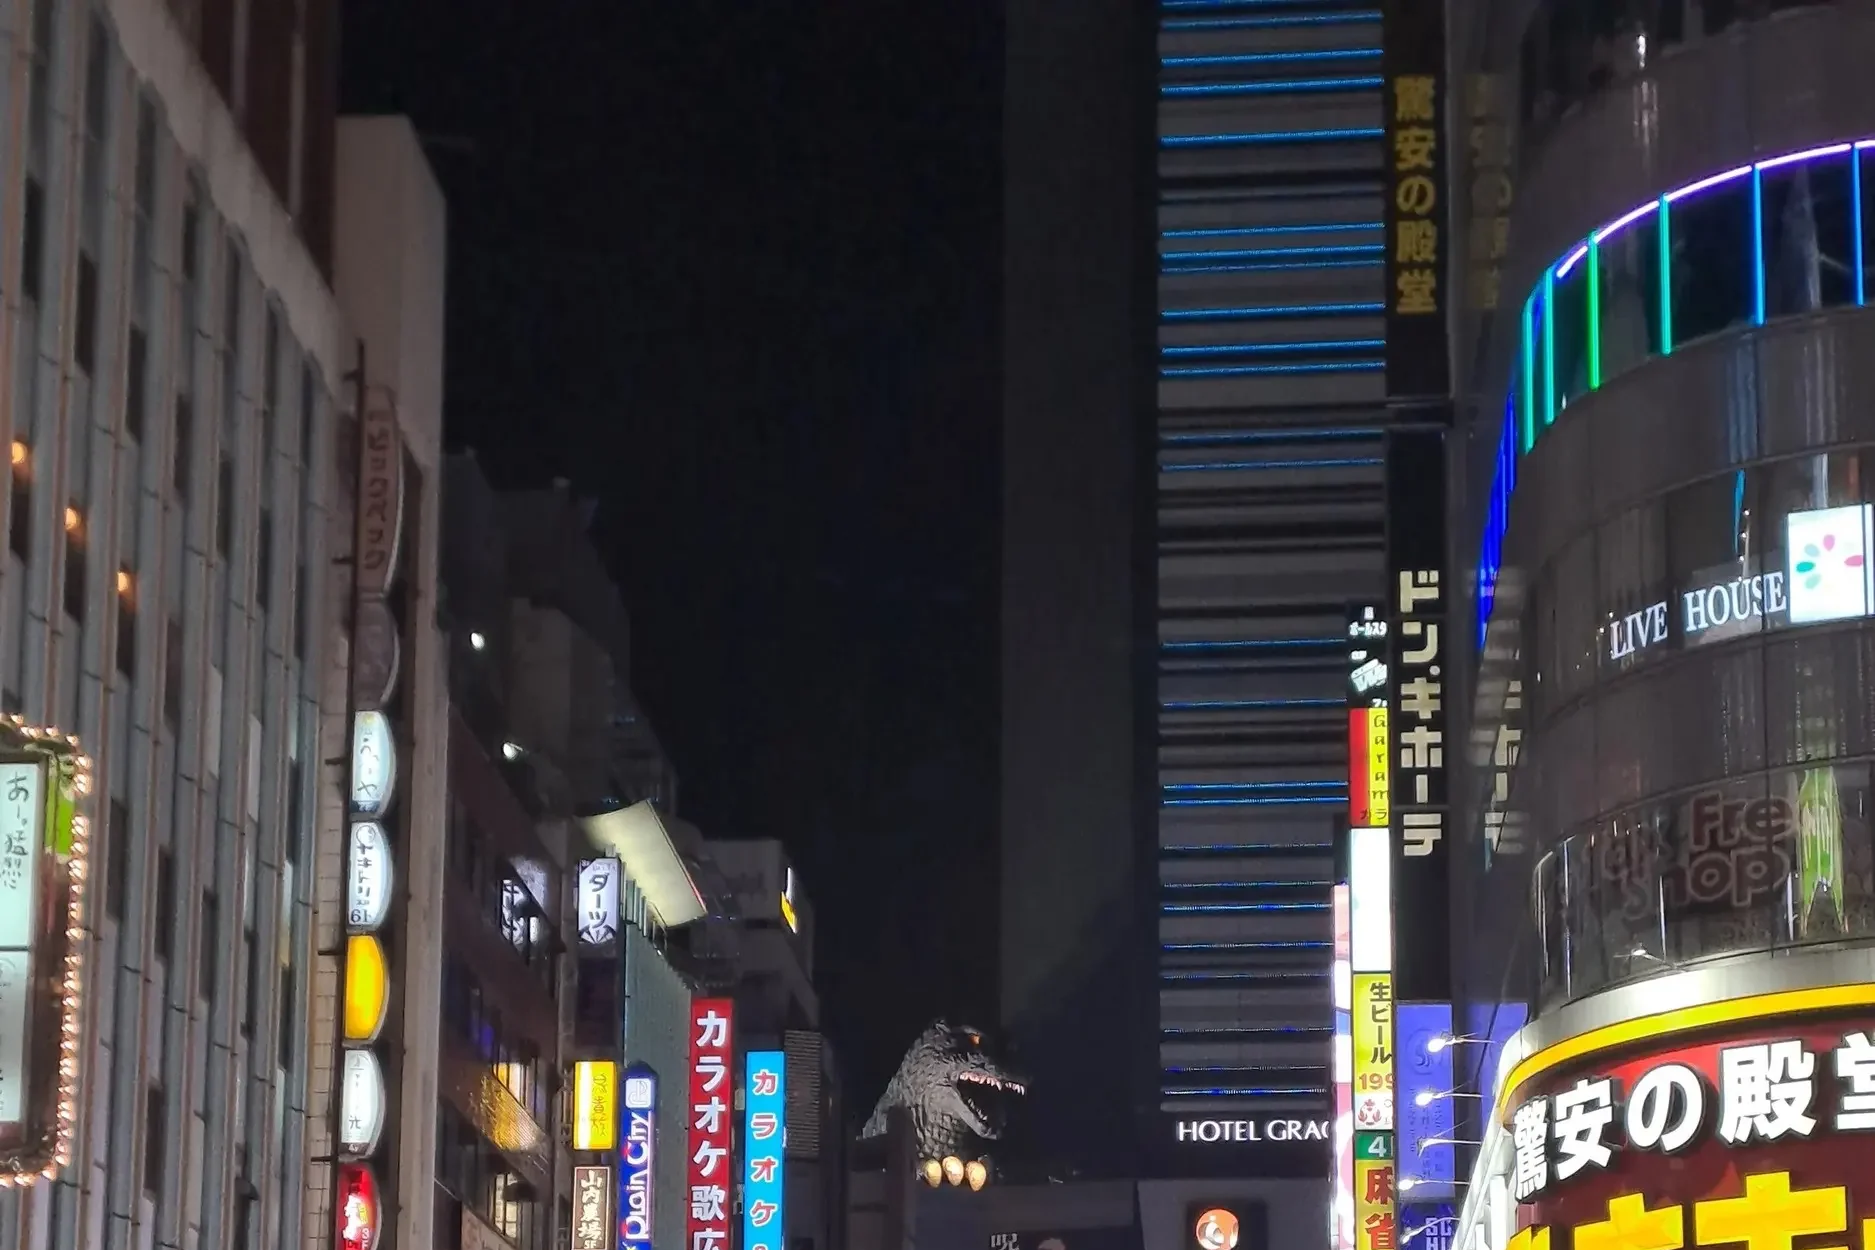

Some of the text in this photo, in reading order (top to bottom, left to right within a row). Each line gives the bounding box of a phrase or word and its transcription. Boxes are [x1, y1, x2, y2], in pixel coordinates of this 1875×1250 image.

[1396, 75, 1437, 314] 驚安の殿堂
[1610, 572, 1787, 660] LIVE HOUSE
[588, 872, 610, 929] ダーツ
[1370, 983, 1393, 1064] 生ビール
[1179, 1121, 1260, 1141] HOTEL
[1368, 1136, 1394, 1157] 4
[578, 1169, 604, 1239] 山内農場
